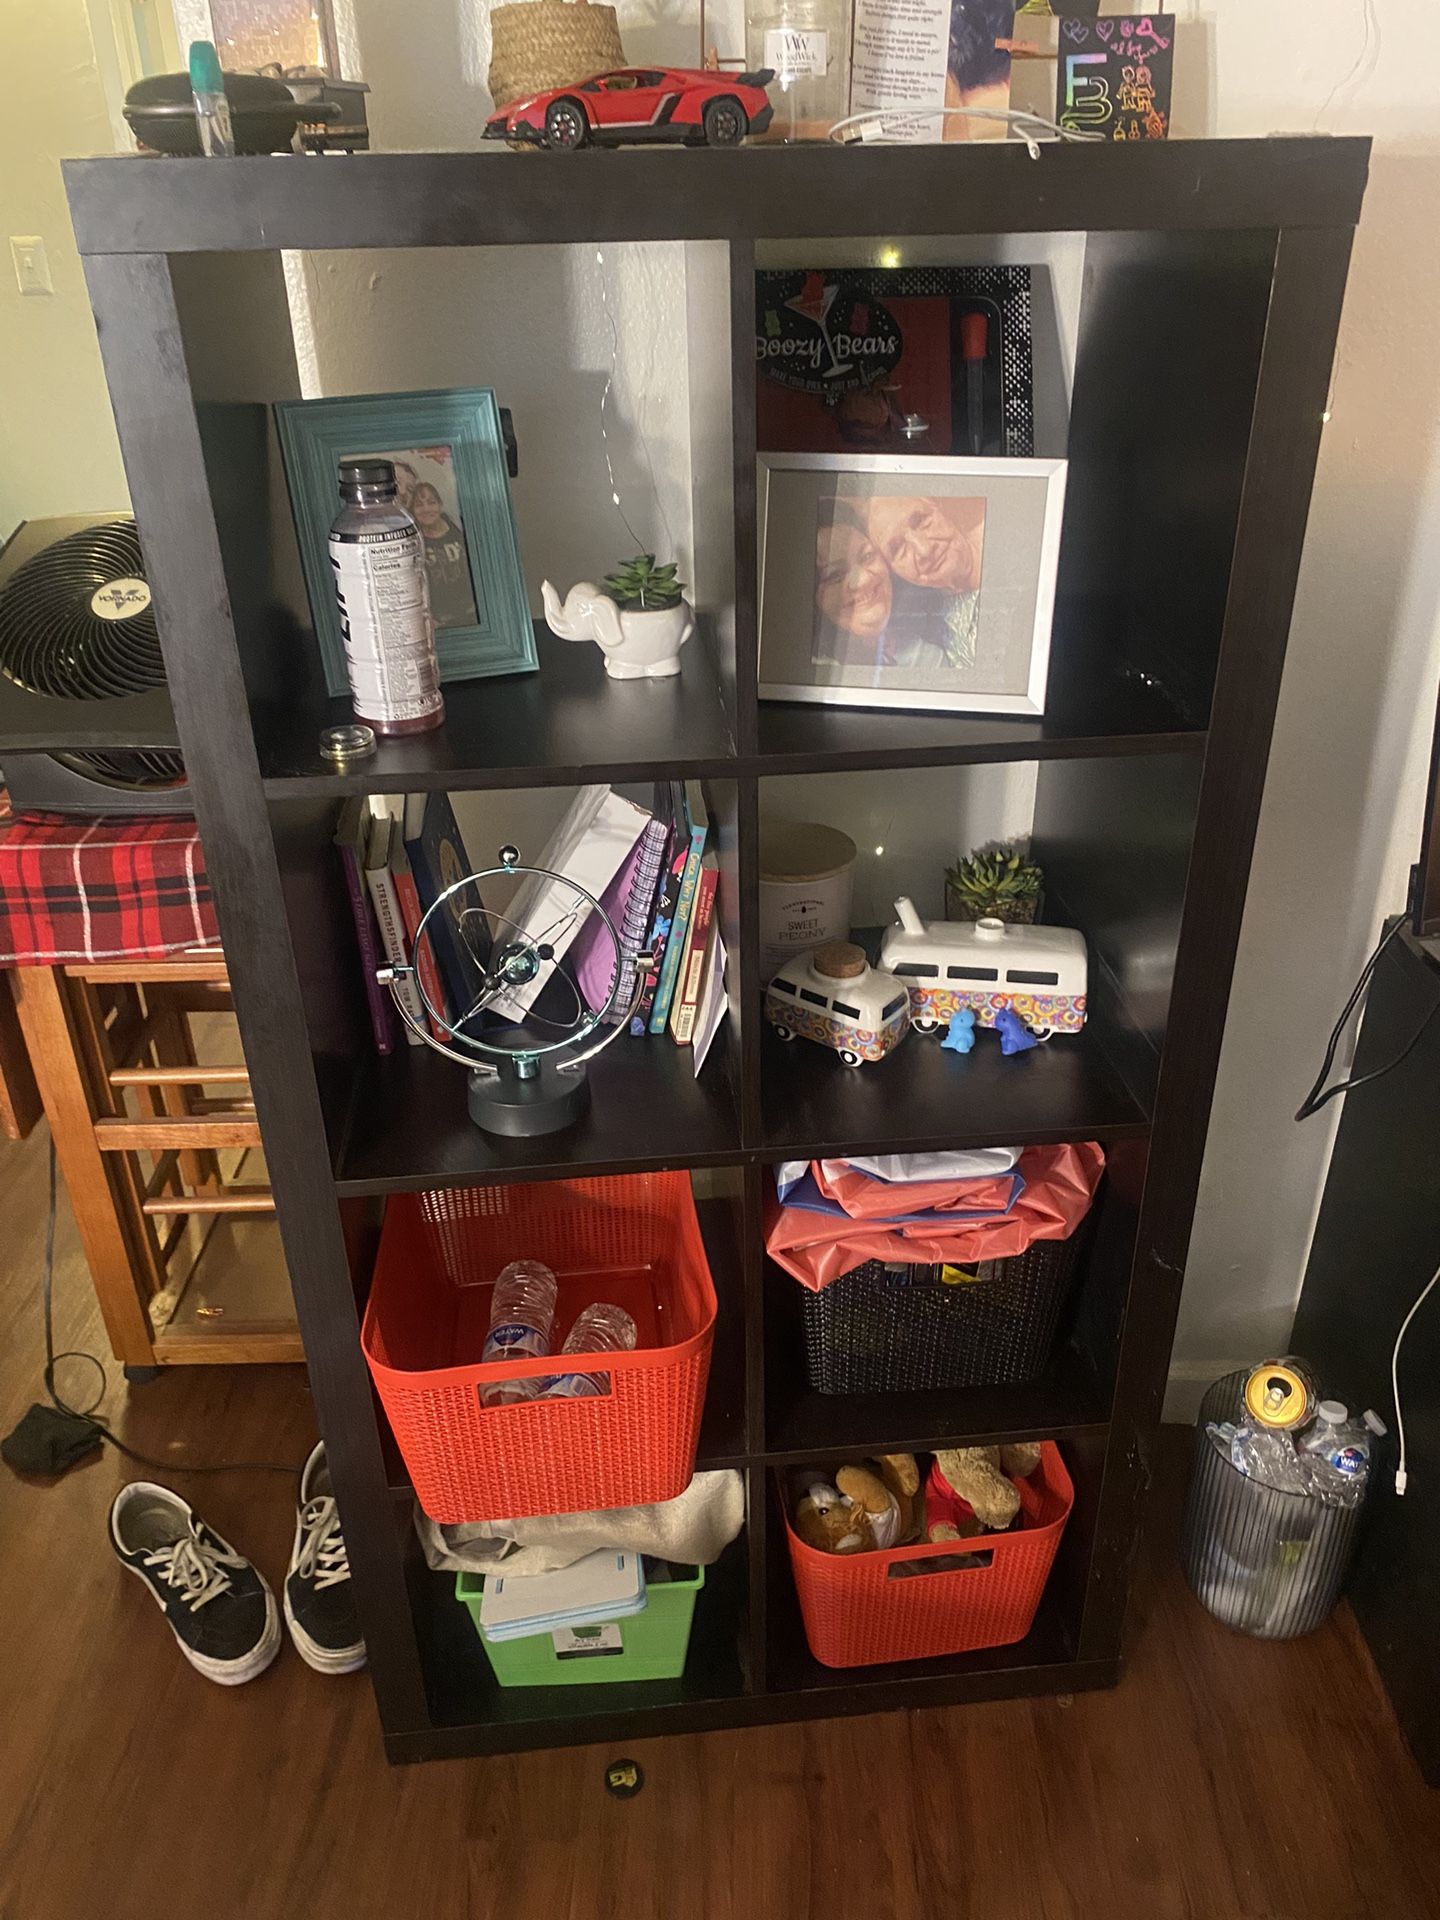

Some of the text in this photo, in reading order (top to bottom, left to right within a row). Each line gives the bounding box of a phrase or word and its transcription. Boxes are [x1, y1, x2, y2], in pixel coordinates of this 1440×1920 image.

[756, 332, 899, 368] Boozy Bears
[370, 546, 401, 555] Nutrition
[98, 593, 147, 602] VORNADO
[376, 883, 402, 963] STRENGTHSFINDER
[788, 918, 818, 930] SWEET
[494, 1327, 525, 1337] WATER
